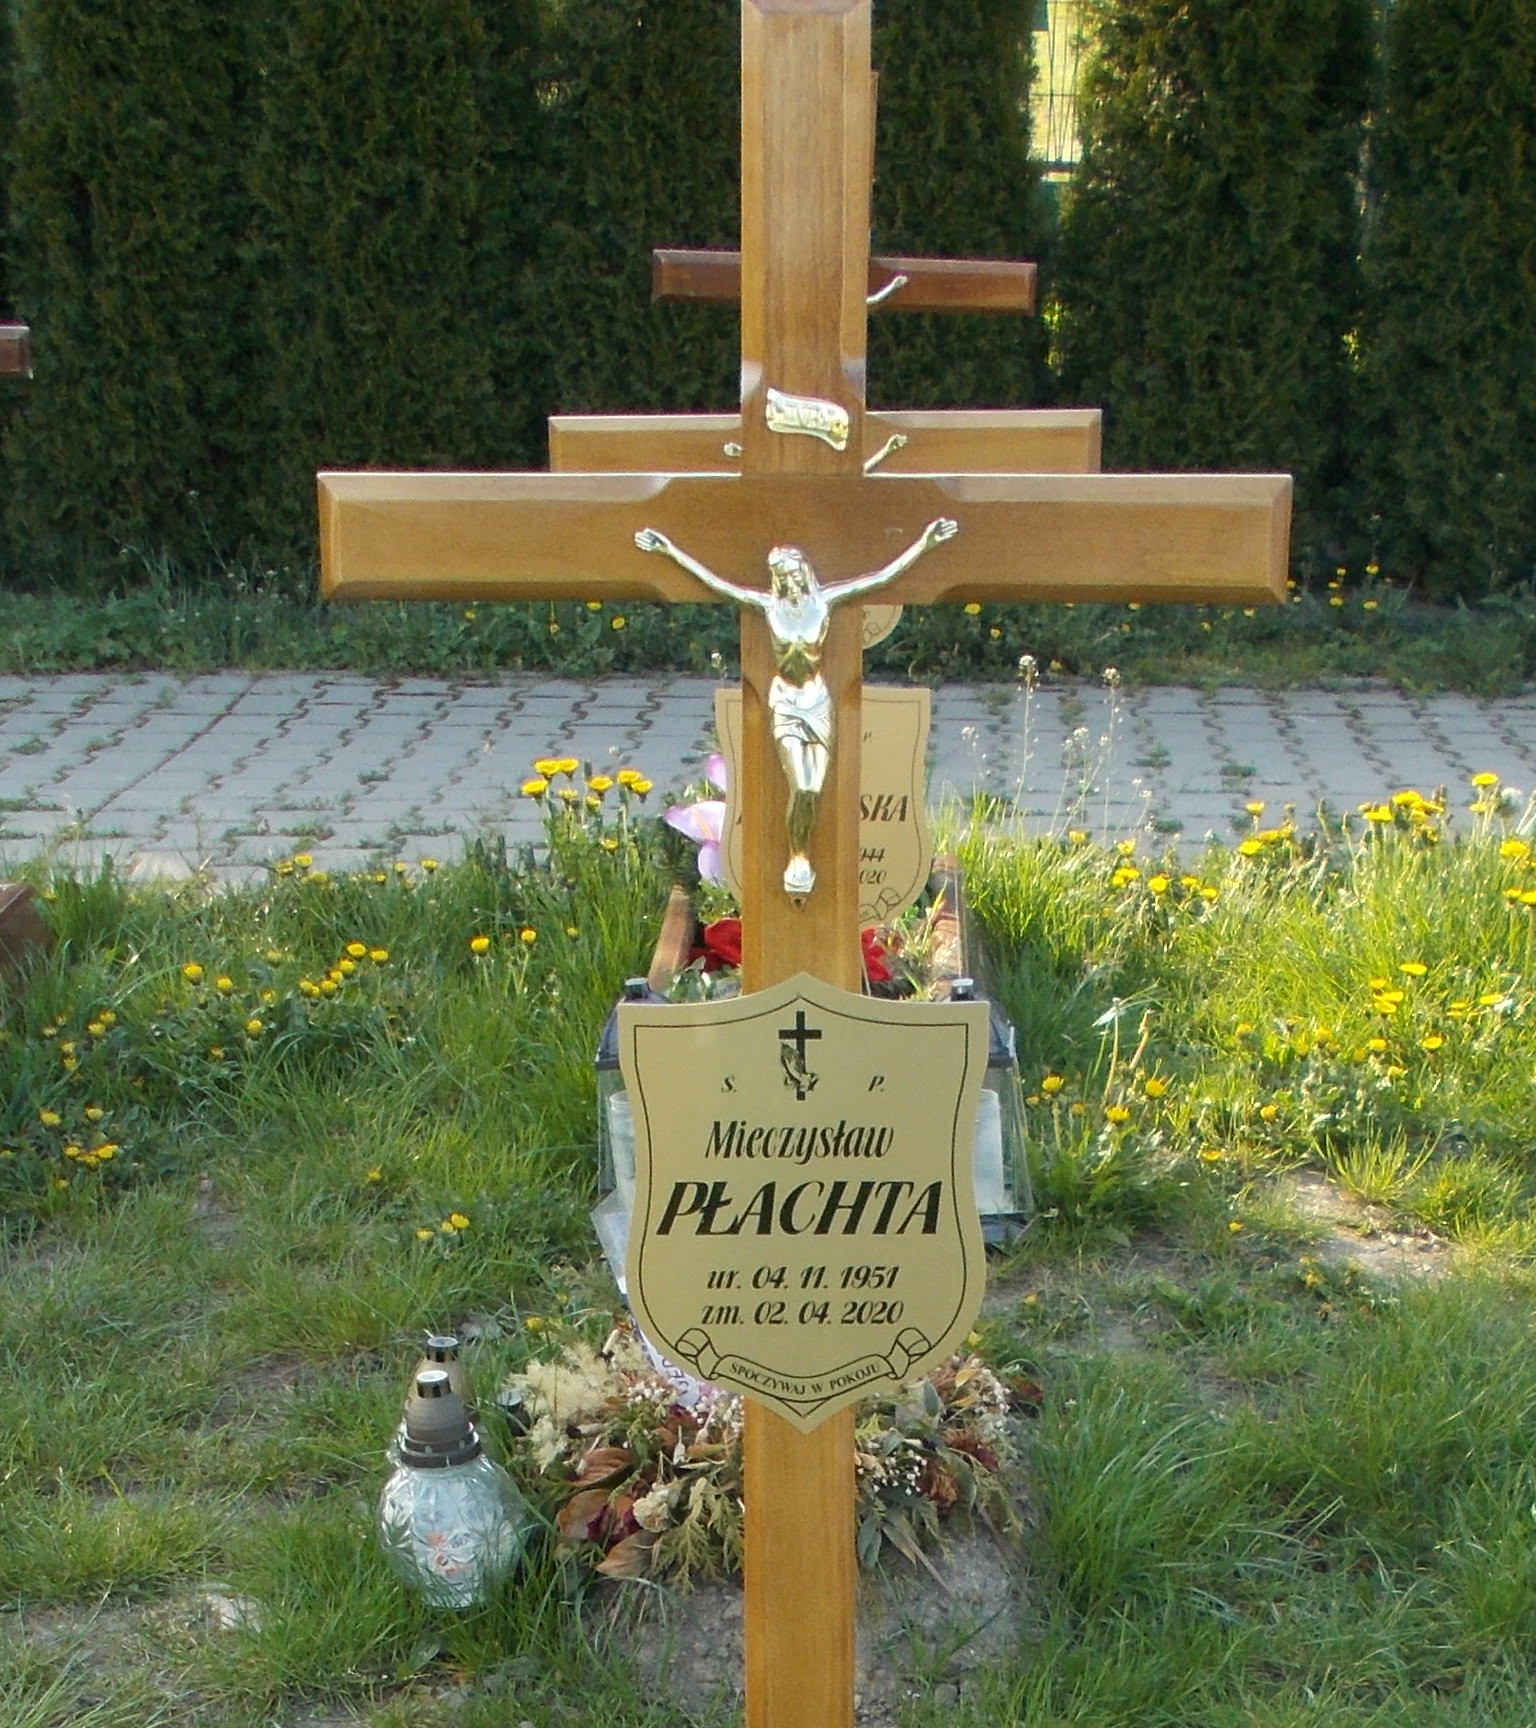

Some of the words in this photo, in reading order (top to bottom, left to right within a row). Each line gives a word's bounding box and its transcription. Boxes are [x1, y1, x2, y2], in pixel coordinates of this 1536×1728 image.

[705, 1119, 895, 1165] Mieczysław
[655, 1180, 943, 1235] PŁACHTA
[707, 1269, 742, 1289] ur.
[752, 1265, 789, 1289] 04.
[800, 1265, 828, 1289] 11.
[840, 1265, 900, 1289] 1951
[701, 1304, 744, 1325] zm.
[754, 1300, 789, 1325] 02.
[798, 1300, 832, 1325] 04.
[840, 1300, 905, 1325] 2020
[729, 1362, 806, 1395] SPOCZYWAJ
[811, 1382, 825, 1394] W
[829, 1362, 881, 1391] POKOJU
